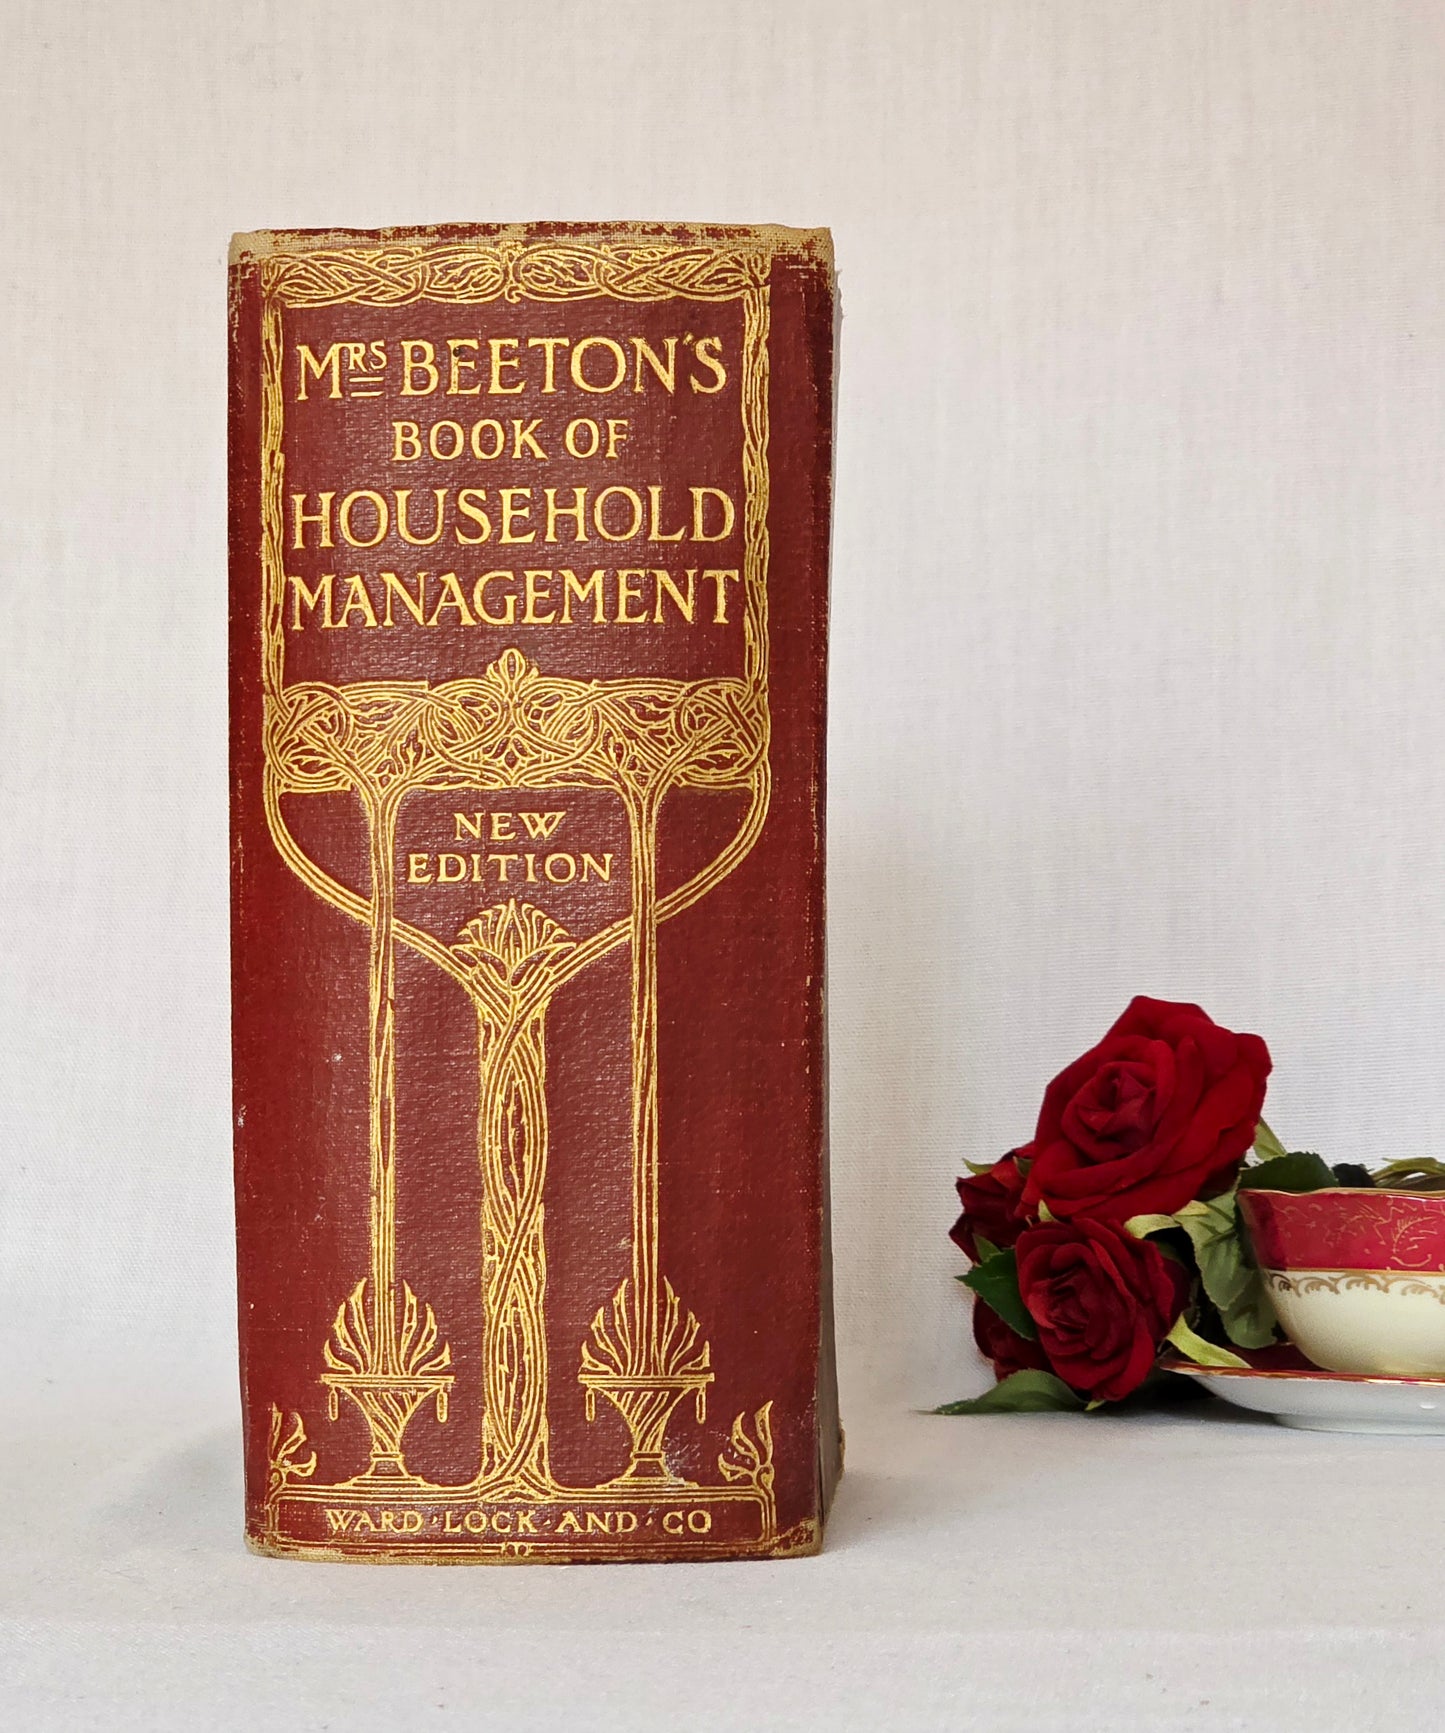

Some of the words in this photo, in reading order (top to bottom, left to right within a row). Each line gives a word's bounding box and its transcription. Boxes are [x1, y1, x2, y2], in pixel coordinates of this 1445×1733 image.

[391, 419, 549, 463] BOOK
[564, 417, 630, 460] OF
[291, 487, 736, 550] HOUSEHOLD
[289, 569, 740, 631] MANAGEMENT
[453, 811, 567, 841] NEW
[407, 852, 614, 884] EDITION
[325, 1508, 424, 1535] WARD
[443, 1509, 536, 1535] LOCK
[555, 1508, 638, 1534] AND
[661, 1508, 712, 1534] CO
